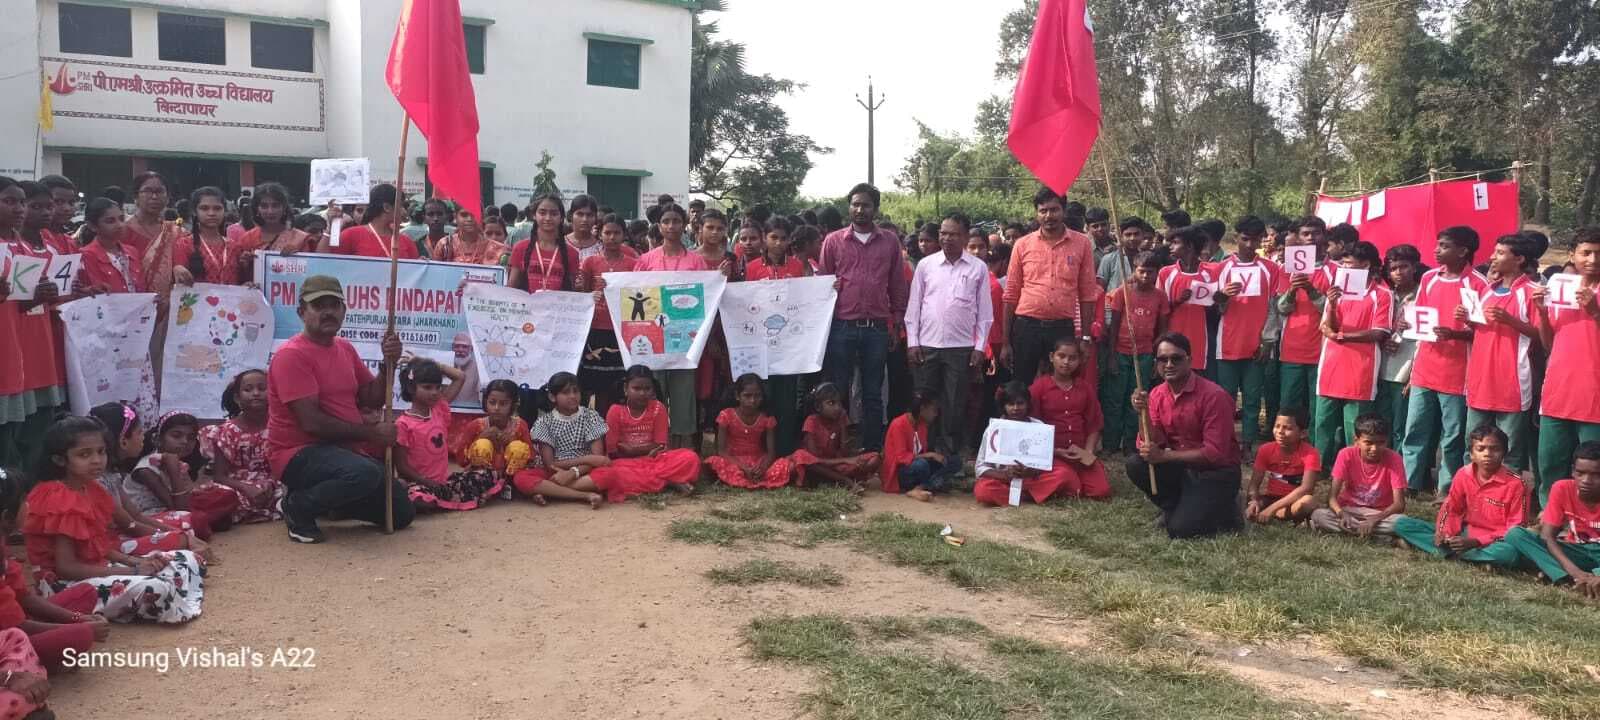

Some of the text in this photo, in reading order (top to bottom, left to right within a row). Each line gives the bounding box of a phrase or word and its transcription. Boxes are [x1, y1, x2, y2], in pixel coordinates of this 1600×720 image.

[77, 71, 91, 80] PM
[195, 83, 224, 99] उच्च
[225, 82, 274, 103] विद्यालय
[1294, 250, 1307, 271] S
[11, 261, 40, 293] K
[55, 261, 72, 291] 4
[1344, 273, 1358, 295] L
[271, 281, 296, 305] PM
[347, 285, 380, 310] UHS
[1195, 286, 1210, 299] D
[1551, 279, 1573, 305] I
[1415, 311, 1428, 334] E
[360, 331, 379, 339] CODE
